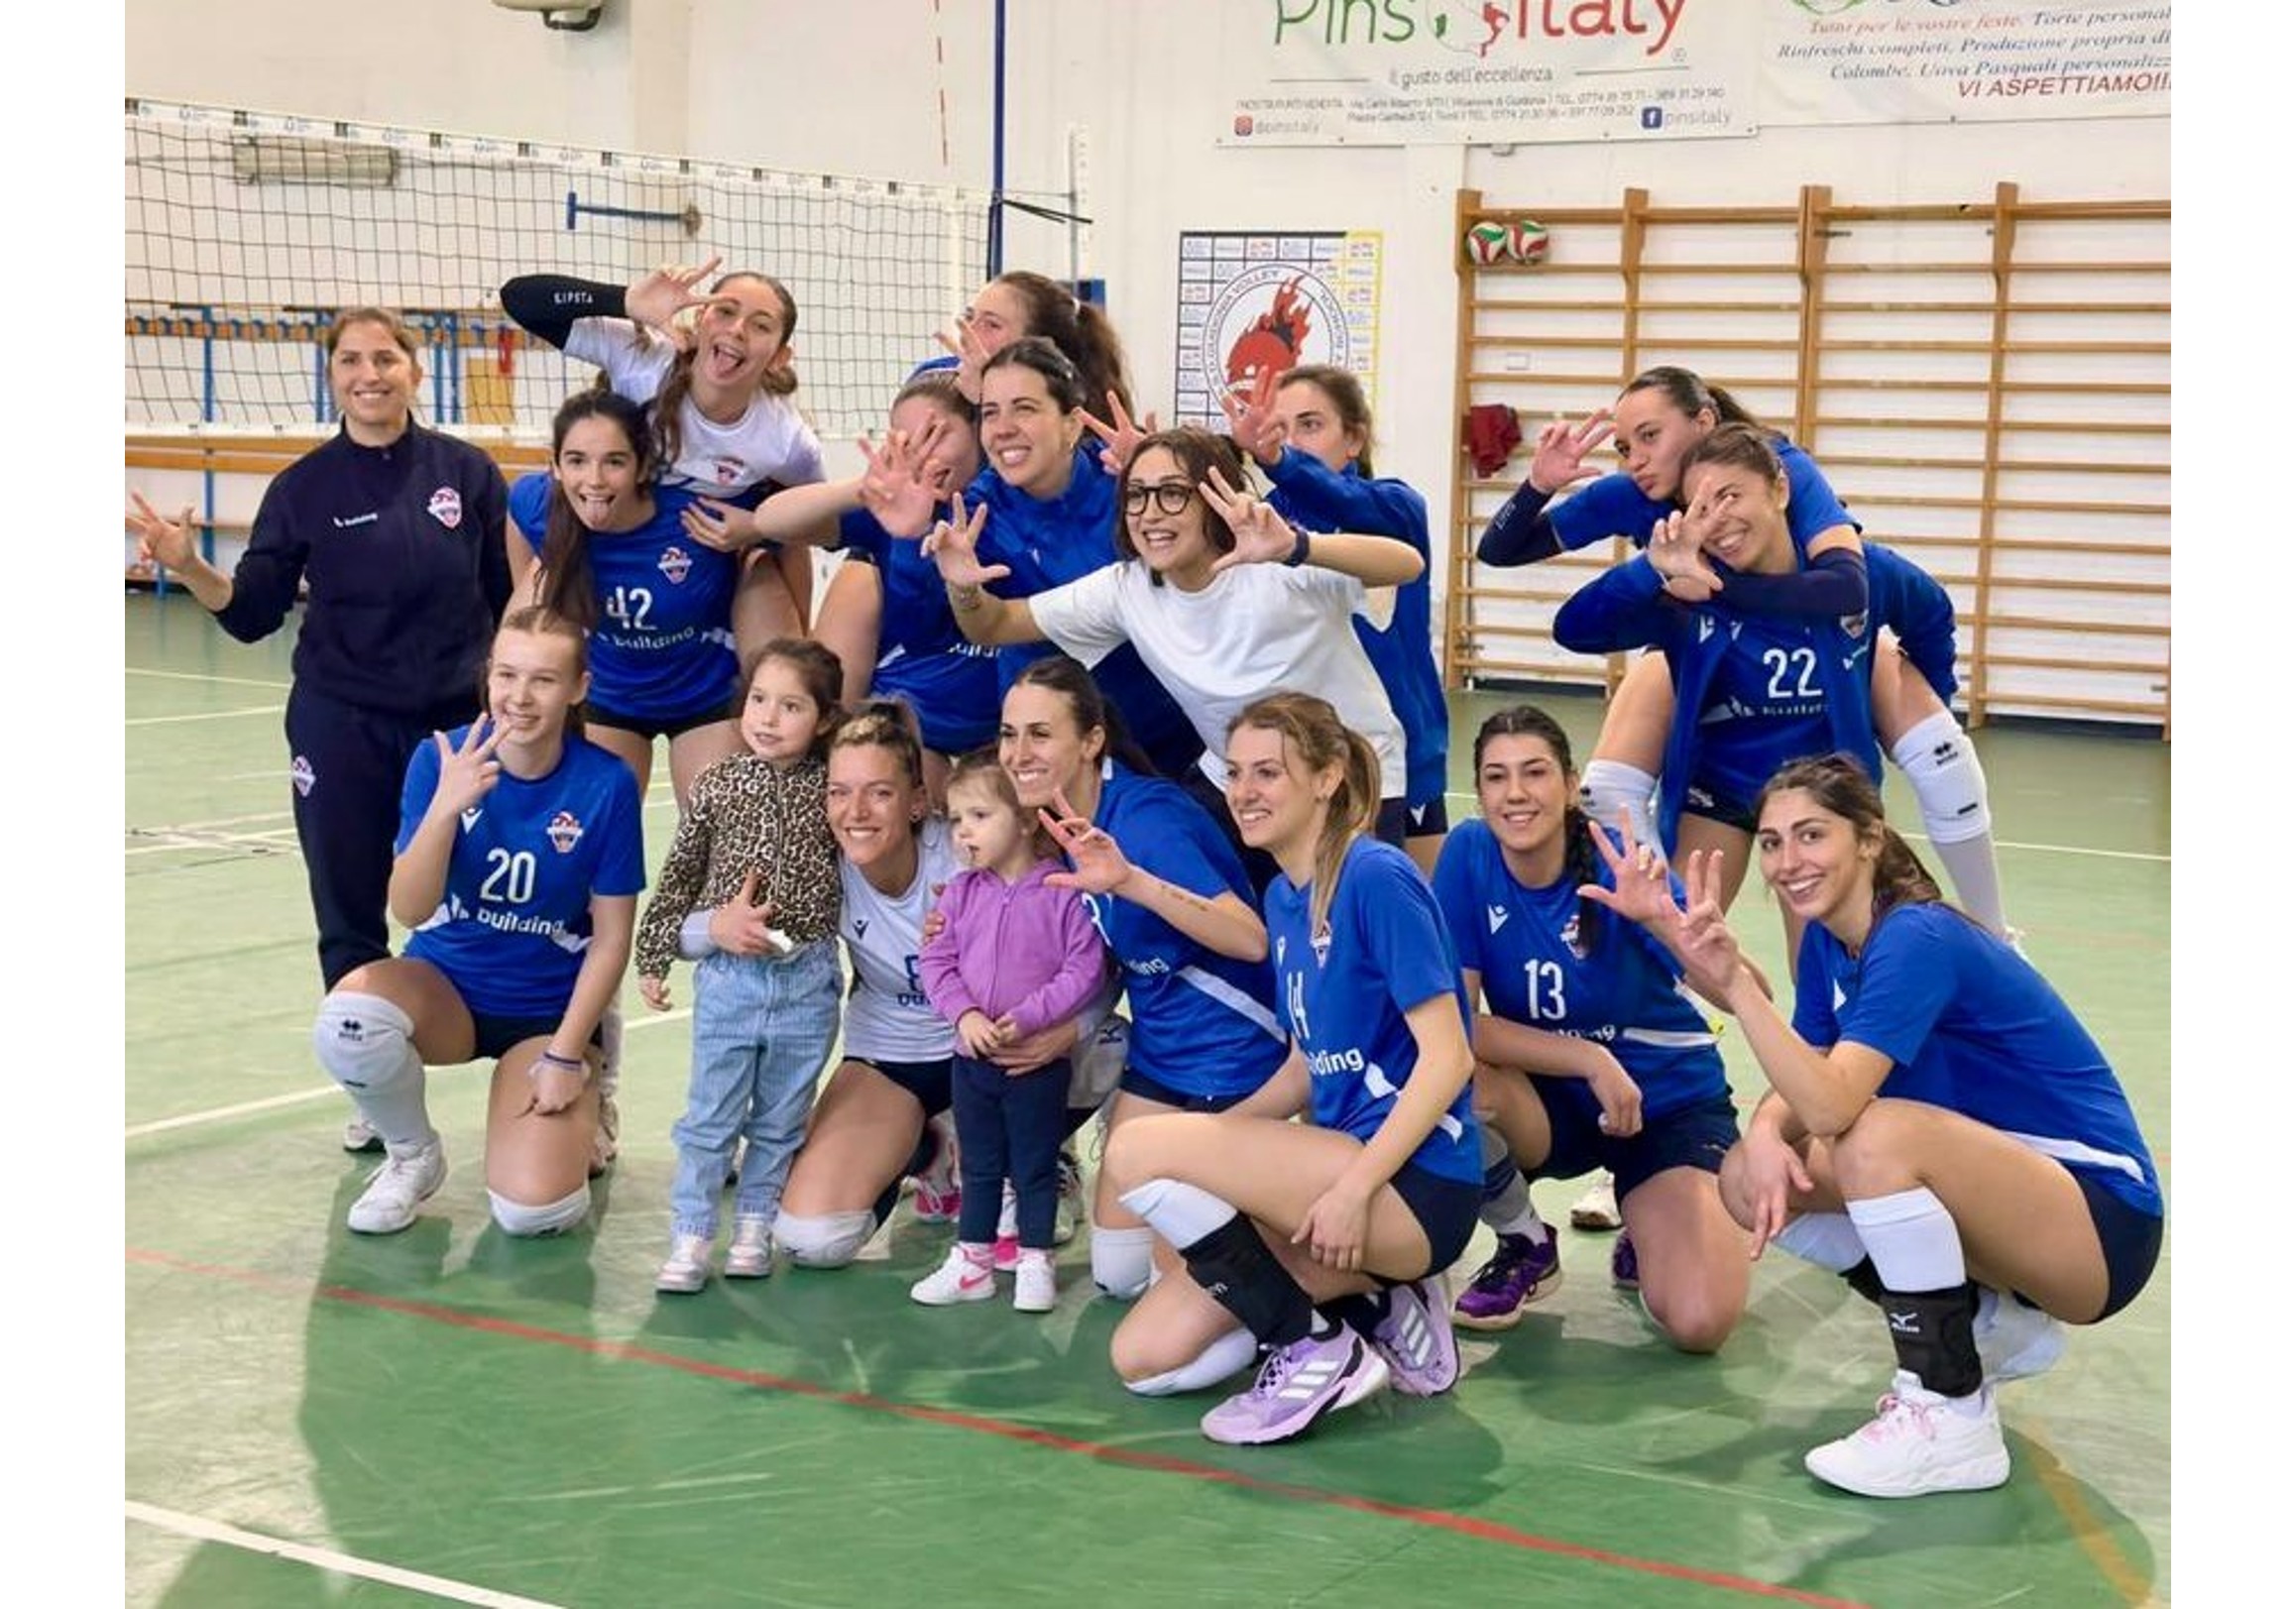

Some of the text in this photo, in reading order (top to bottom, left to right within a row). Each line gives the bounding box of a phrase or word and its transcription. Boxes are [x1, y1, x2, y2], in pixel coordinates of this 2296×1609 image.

[1961, 36, 2067, 53] Produzione
[1402, 70, 1441, 91] gusto
[1958, 71, 2171, 98] VI ASPETTIAMO!!
[1975, 57, 2058, 77] Pasquali
[606, 585, 658, 631] 42
[1763, 646, 1823, 699] 22
[479, 847, 536, 904] 20
[1524, 958, 1567, 1020] 13
